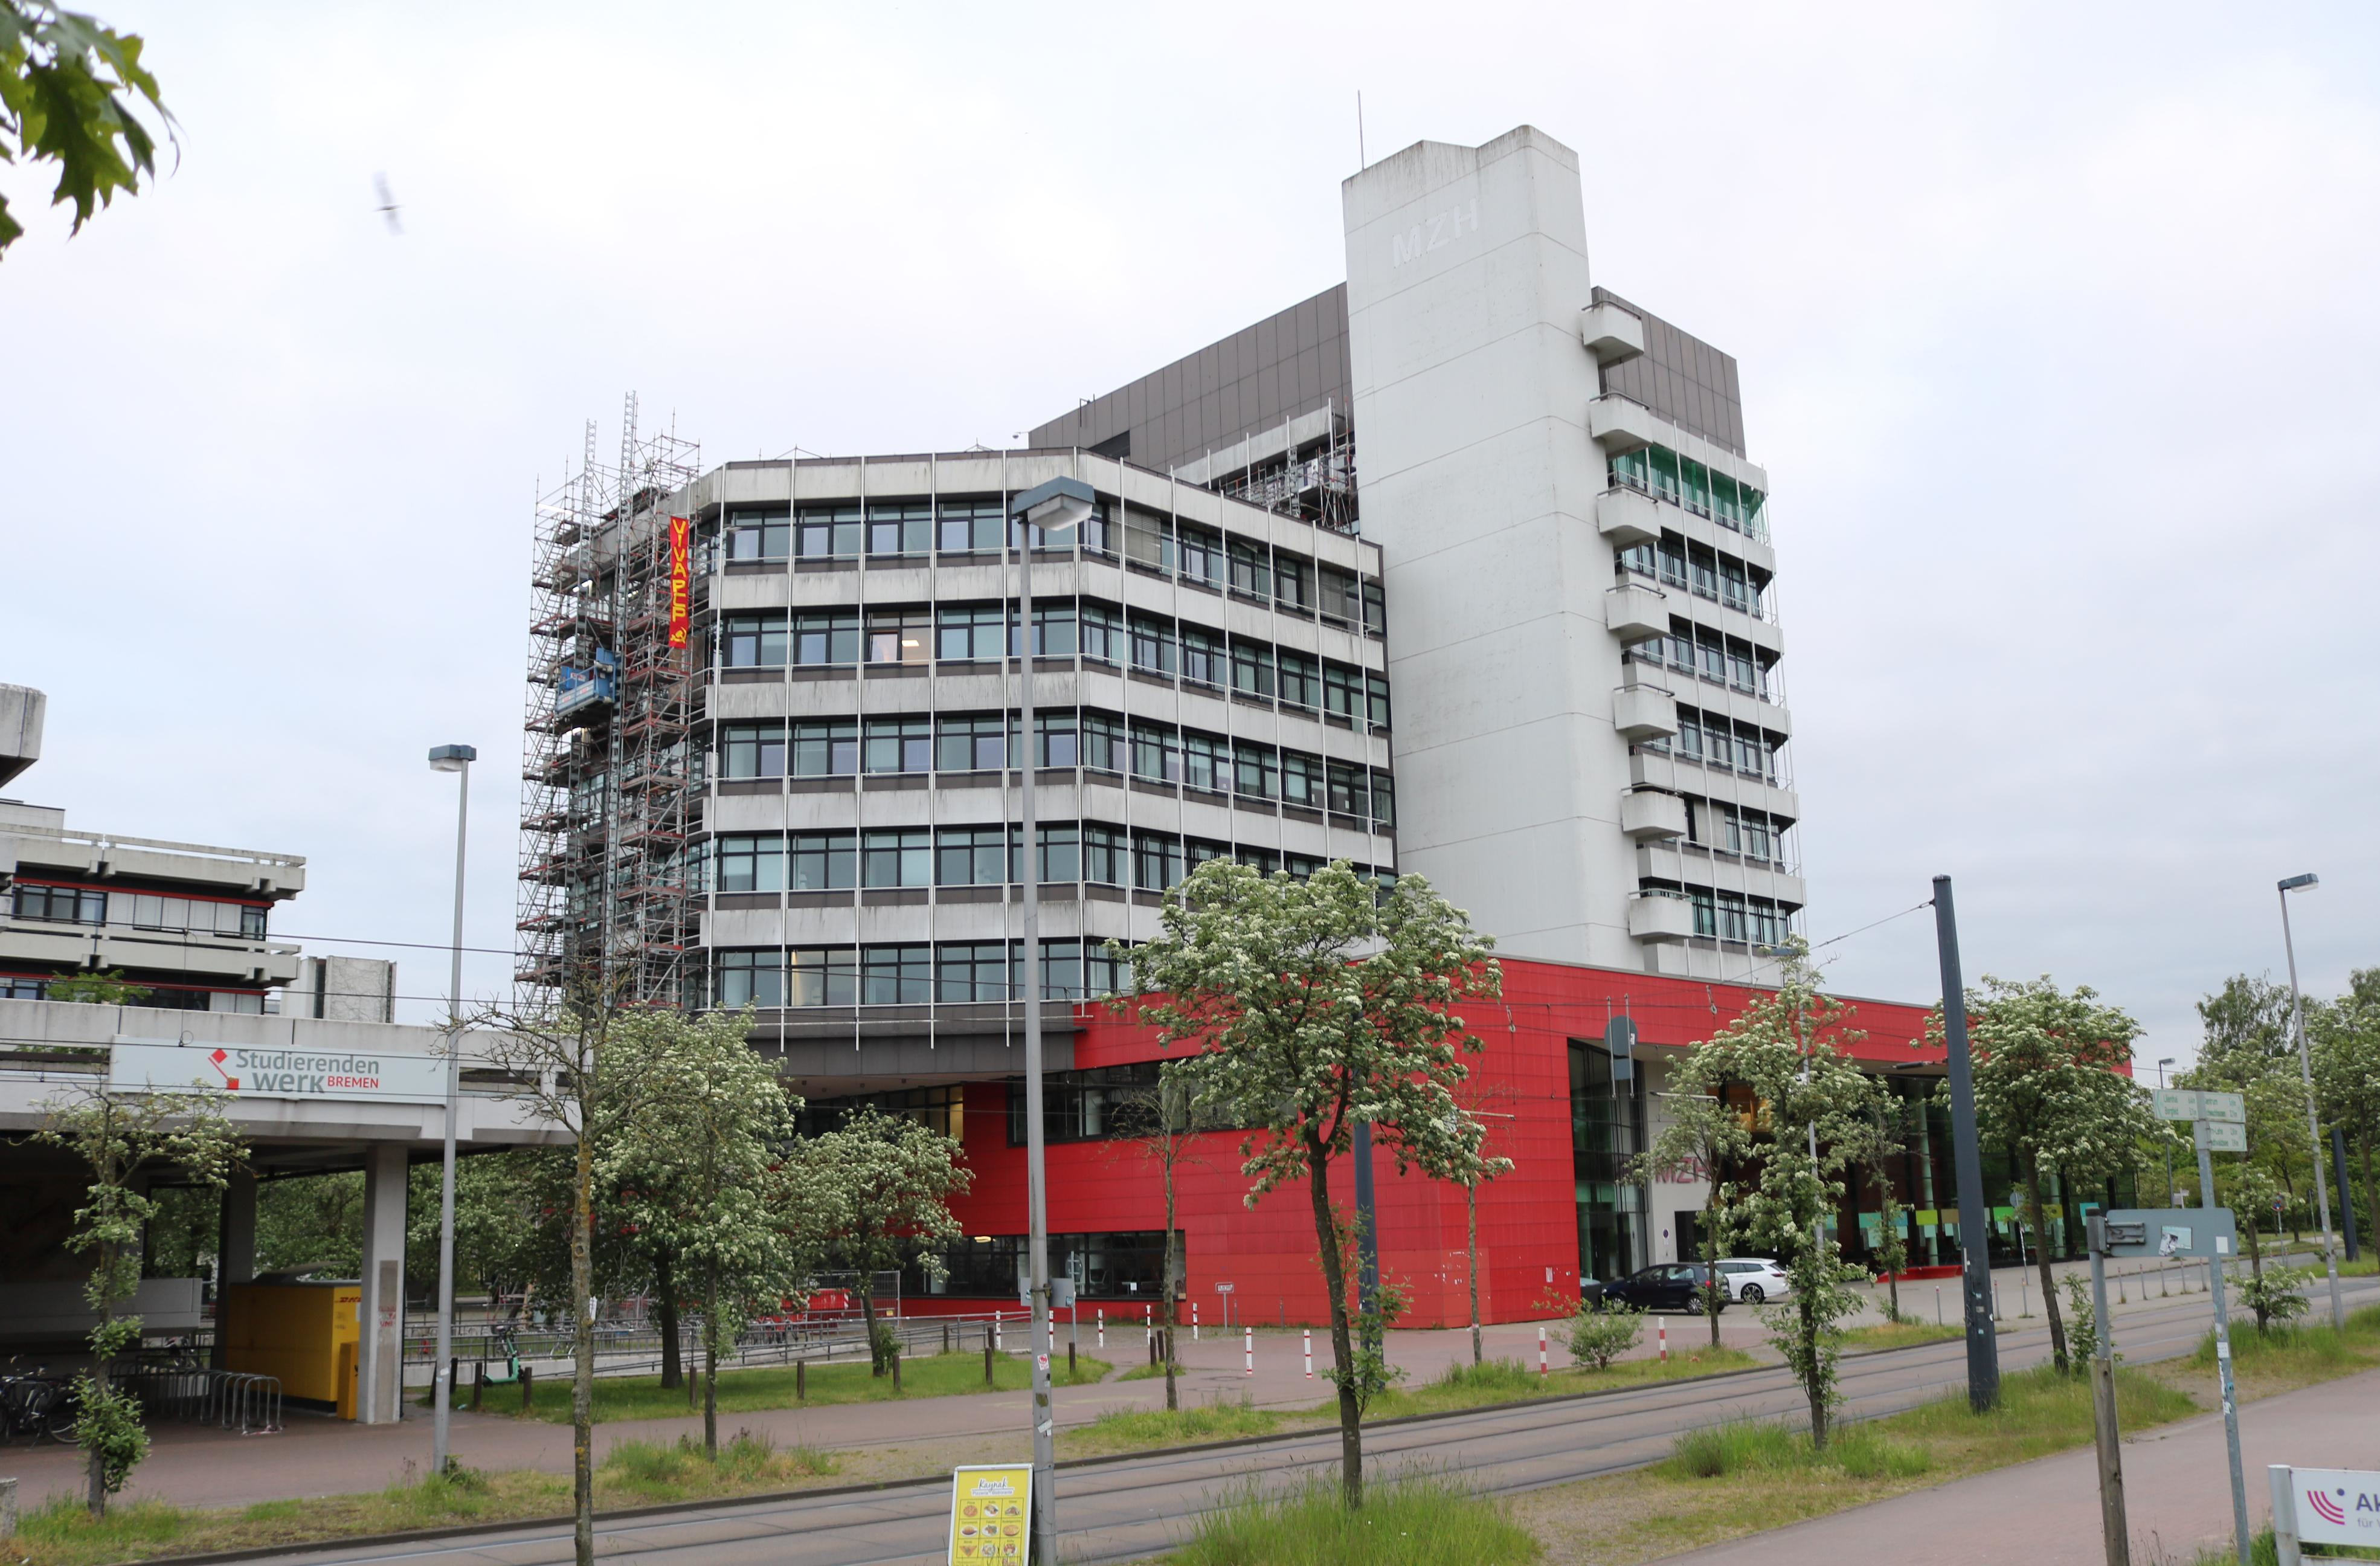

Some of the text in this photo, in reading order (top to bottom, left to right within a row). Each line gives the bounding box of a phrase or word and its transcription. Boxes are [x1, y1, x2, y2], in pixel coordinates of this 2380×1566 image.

[1392, 198, 1479, 268] MZH
[672, 518, 687, 578] VIVA
[236, 1049, 379, 1074] Studierenden
[327, 1075, 379, 1089] BREMEN
[979, 1477, 1007, 1492] Kaynak
[2357, 1516, 2373, 1528] für
